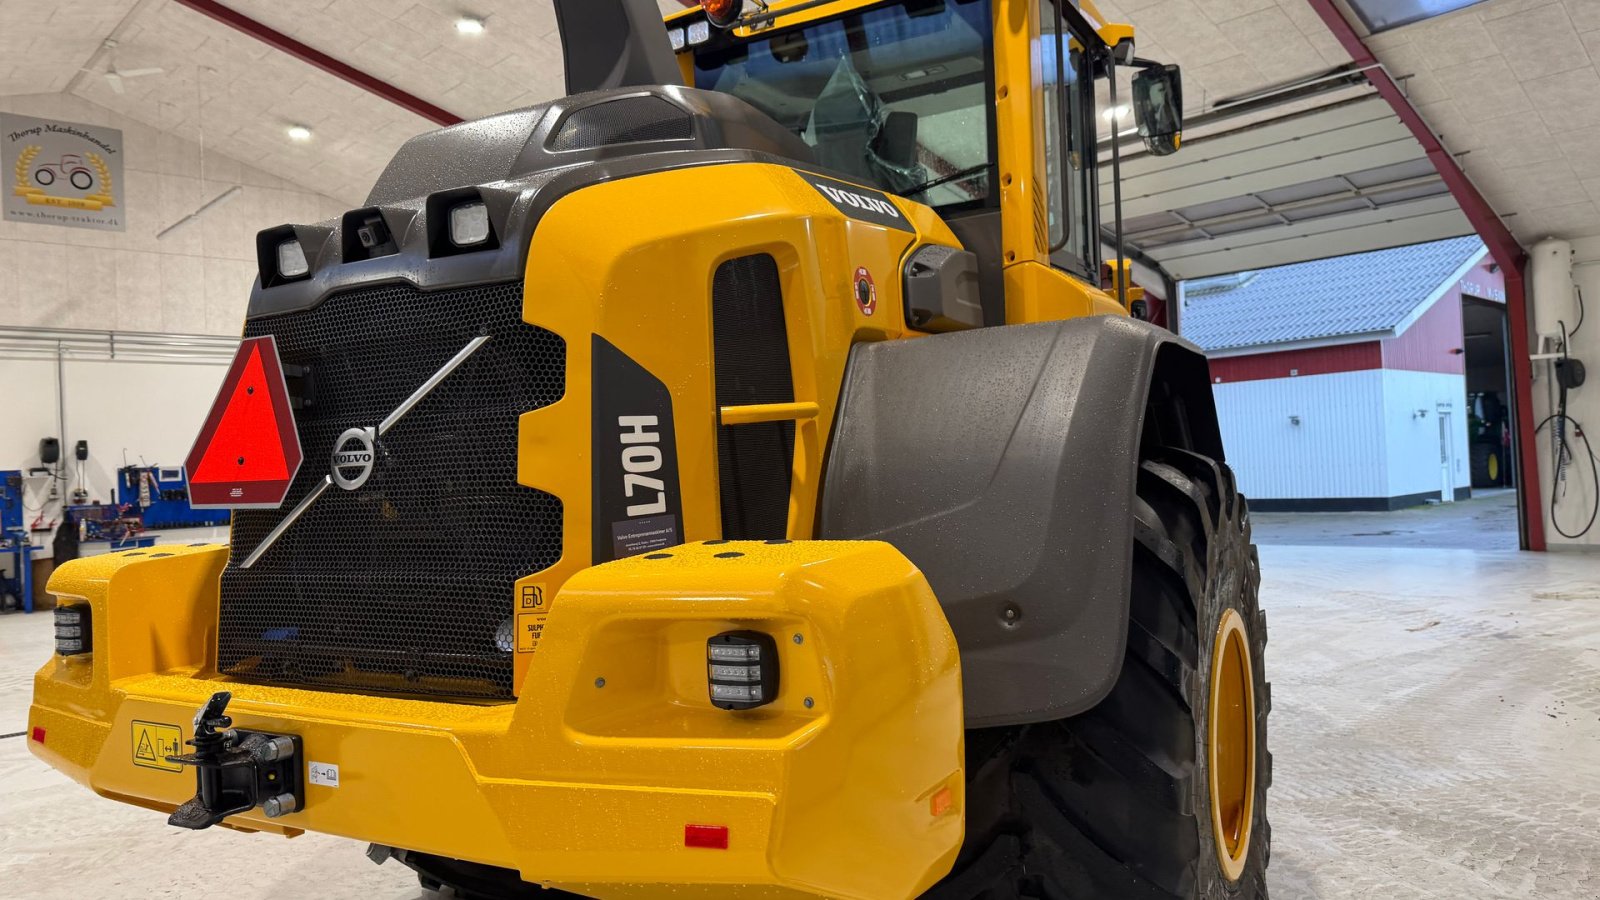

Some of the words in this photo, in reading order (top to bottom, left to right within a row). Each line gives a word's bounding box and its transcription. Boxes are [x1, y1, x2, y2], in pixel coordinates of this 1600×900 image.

[8, 126, 43, 142] Thorup
[44, 124, 117, 155] Maskinhandel
[816, 183, 899, 218] VOLVO
[332, 453, 372, 464] VOLVO
[618, 415, 667, 517] L70H
